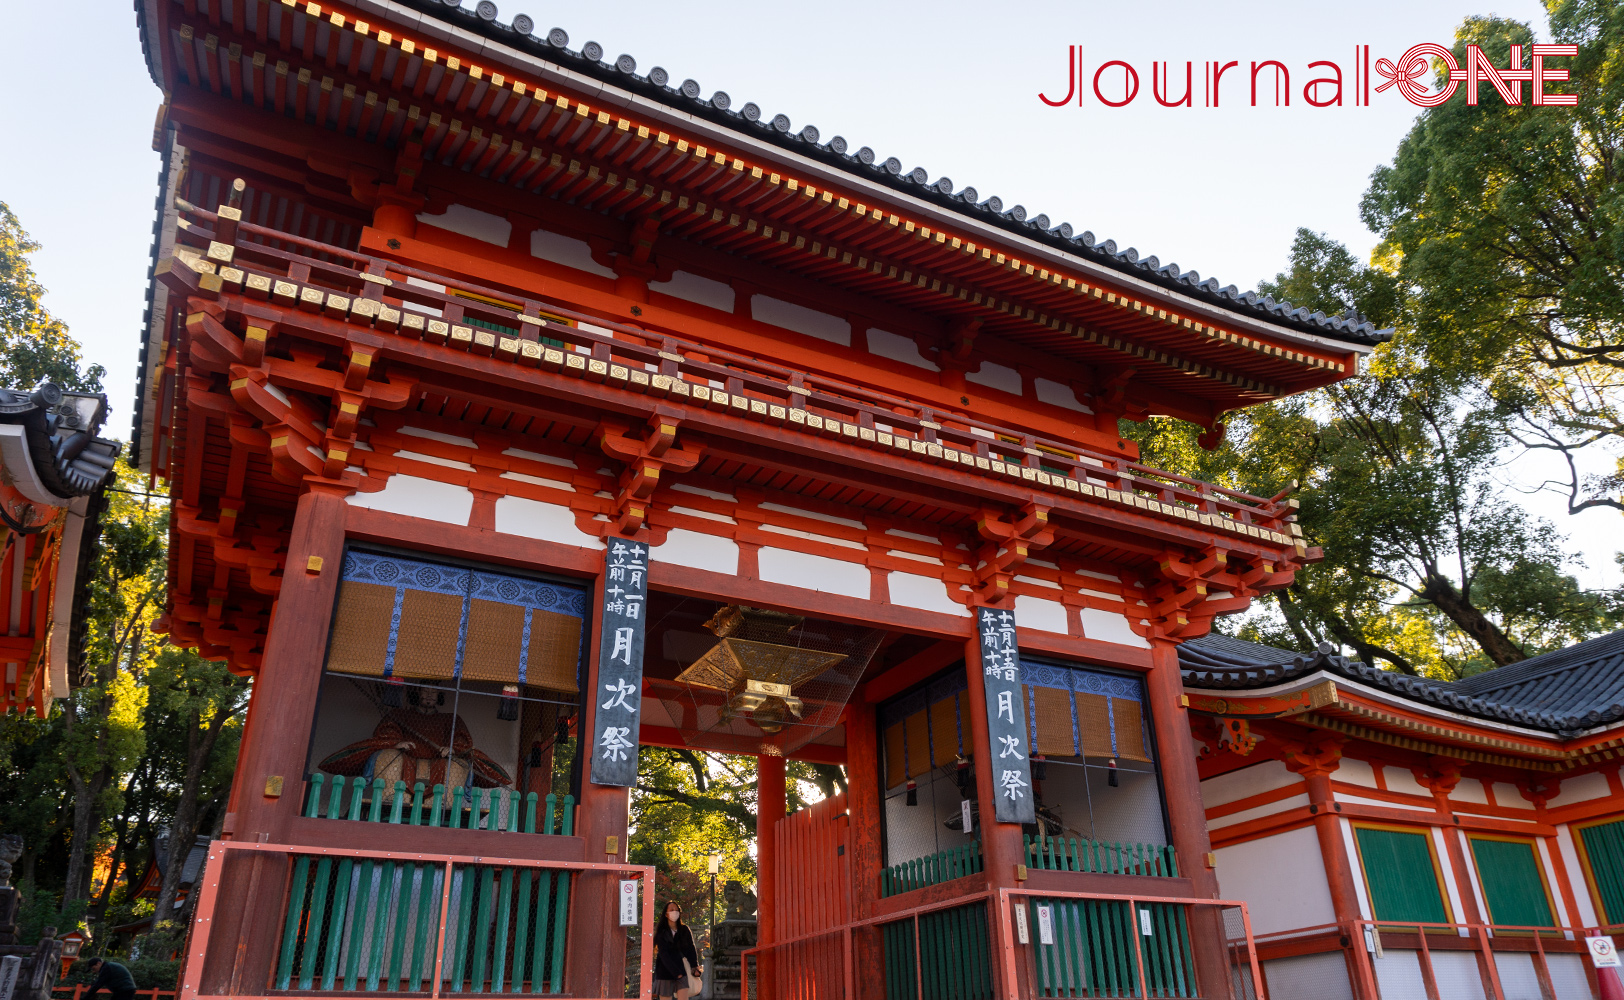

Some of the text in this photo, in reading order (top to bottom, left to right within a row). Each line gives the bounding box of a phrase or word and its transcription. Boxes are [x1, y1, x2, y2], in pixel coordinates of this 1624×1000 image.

[606, 542, 629, 616] 午前十時
[624, 544, 647, 620] 十二月一日
[981, 610, 1002, 680] 午前十時
[998, 610, 1020, 683] 十二月十五日
[600, 627, 638, 763] 月次祭
[997, 690, 1029, 801] 月次祭
